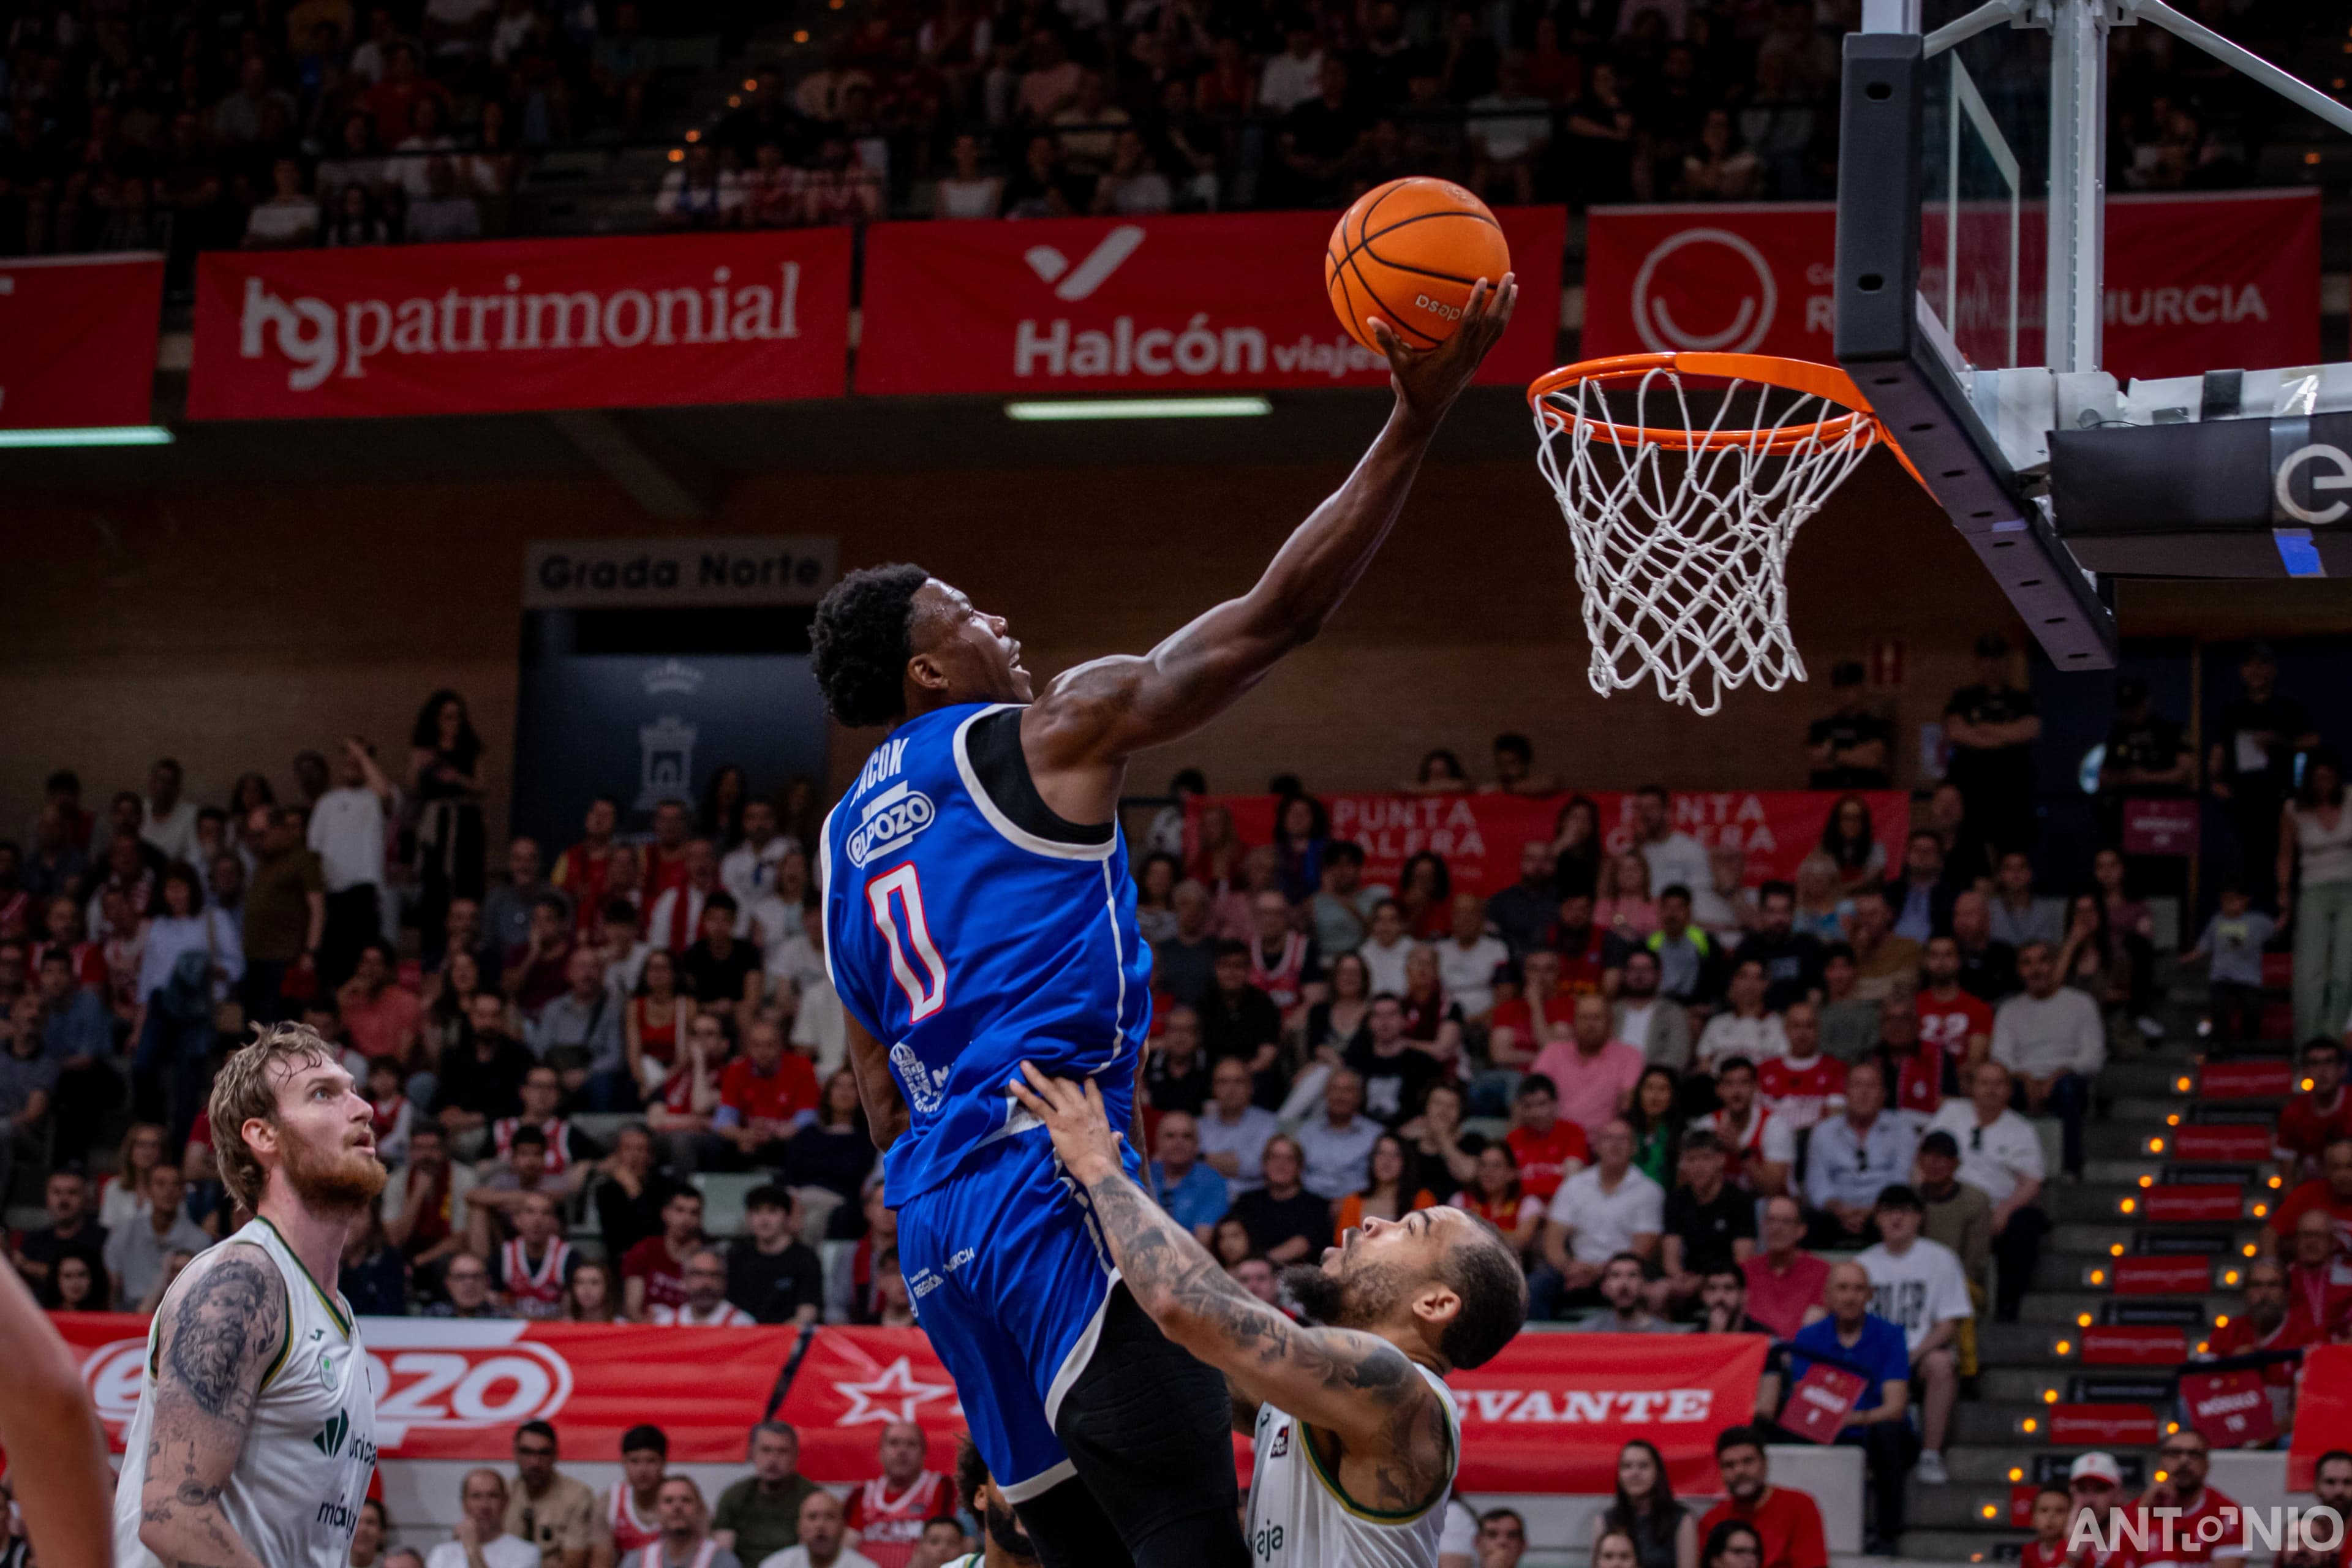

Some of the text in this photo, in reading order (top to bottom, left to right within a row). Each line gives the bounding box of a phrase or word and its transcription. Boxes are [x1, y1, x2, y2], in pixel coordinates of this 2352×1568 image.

[342, 261, 801, 379] patrimonial
[1415, 294, 1461, 321] desa
[1014, 312, 1267, 376] Halcón
[539, 550, 821, 590] Grada Norte
[850, 737, 910, 809] ACOK
[1331, 797, 1477, 831] PUNTA
[1619, 794, 1766, 824] NTA
[1333, 829, 1486, 858] ALERA
[865, 860, 948, 1025] 0
[1253, 1519, 1283, 1562] aja
